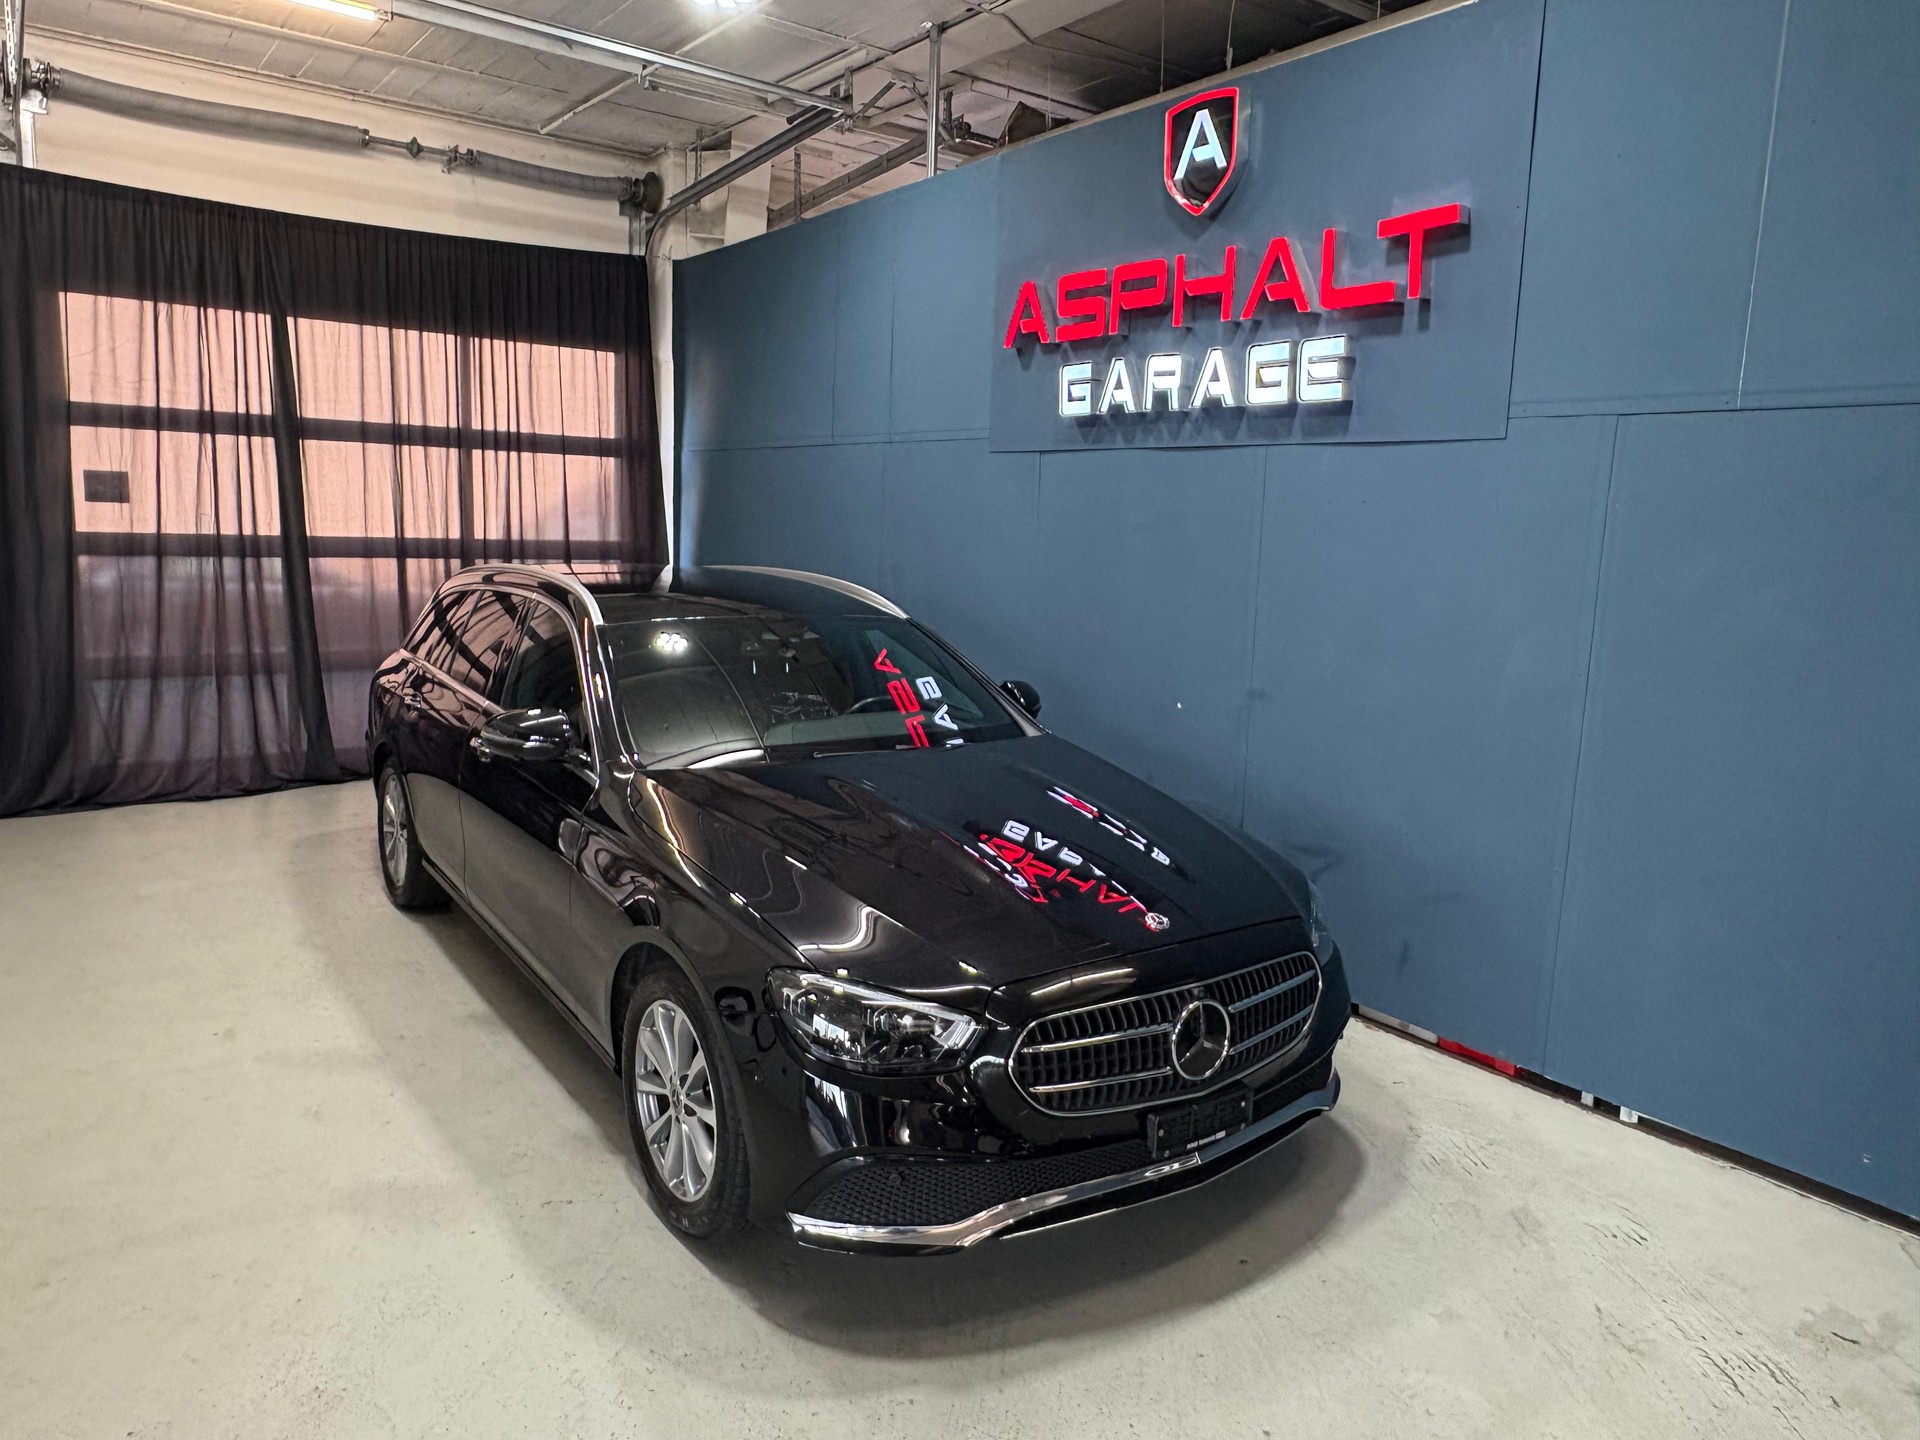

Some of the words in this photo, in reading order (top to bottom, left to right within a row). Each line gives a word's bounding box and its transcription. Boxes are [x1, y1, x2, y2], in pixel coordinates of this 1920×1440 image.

[1173, 108, 1228, 181] A
[1003, 202, 1461, 349] ASPHALT
[1058, 334, 1348, 418] GARAGE
